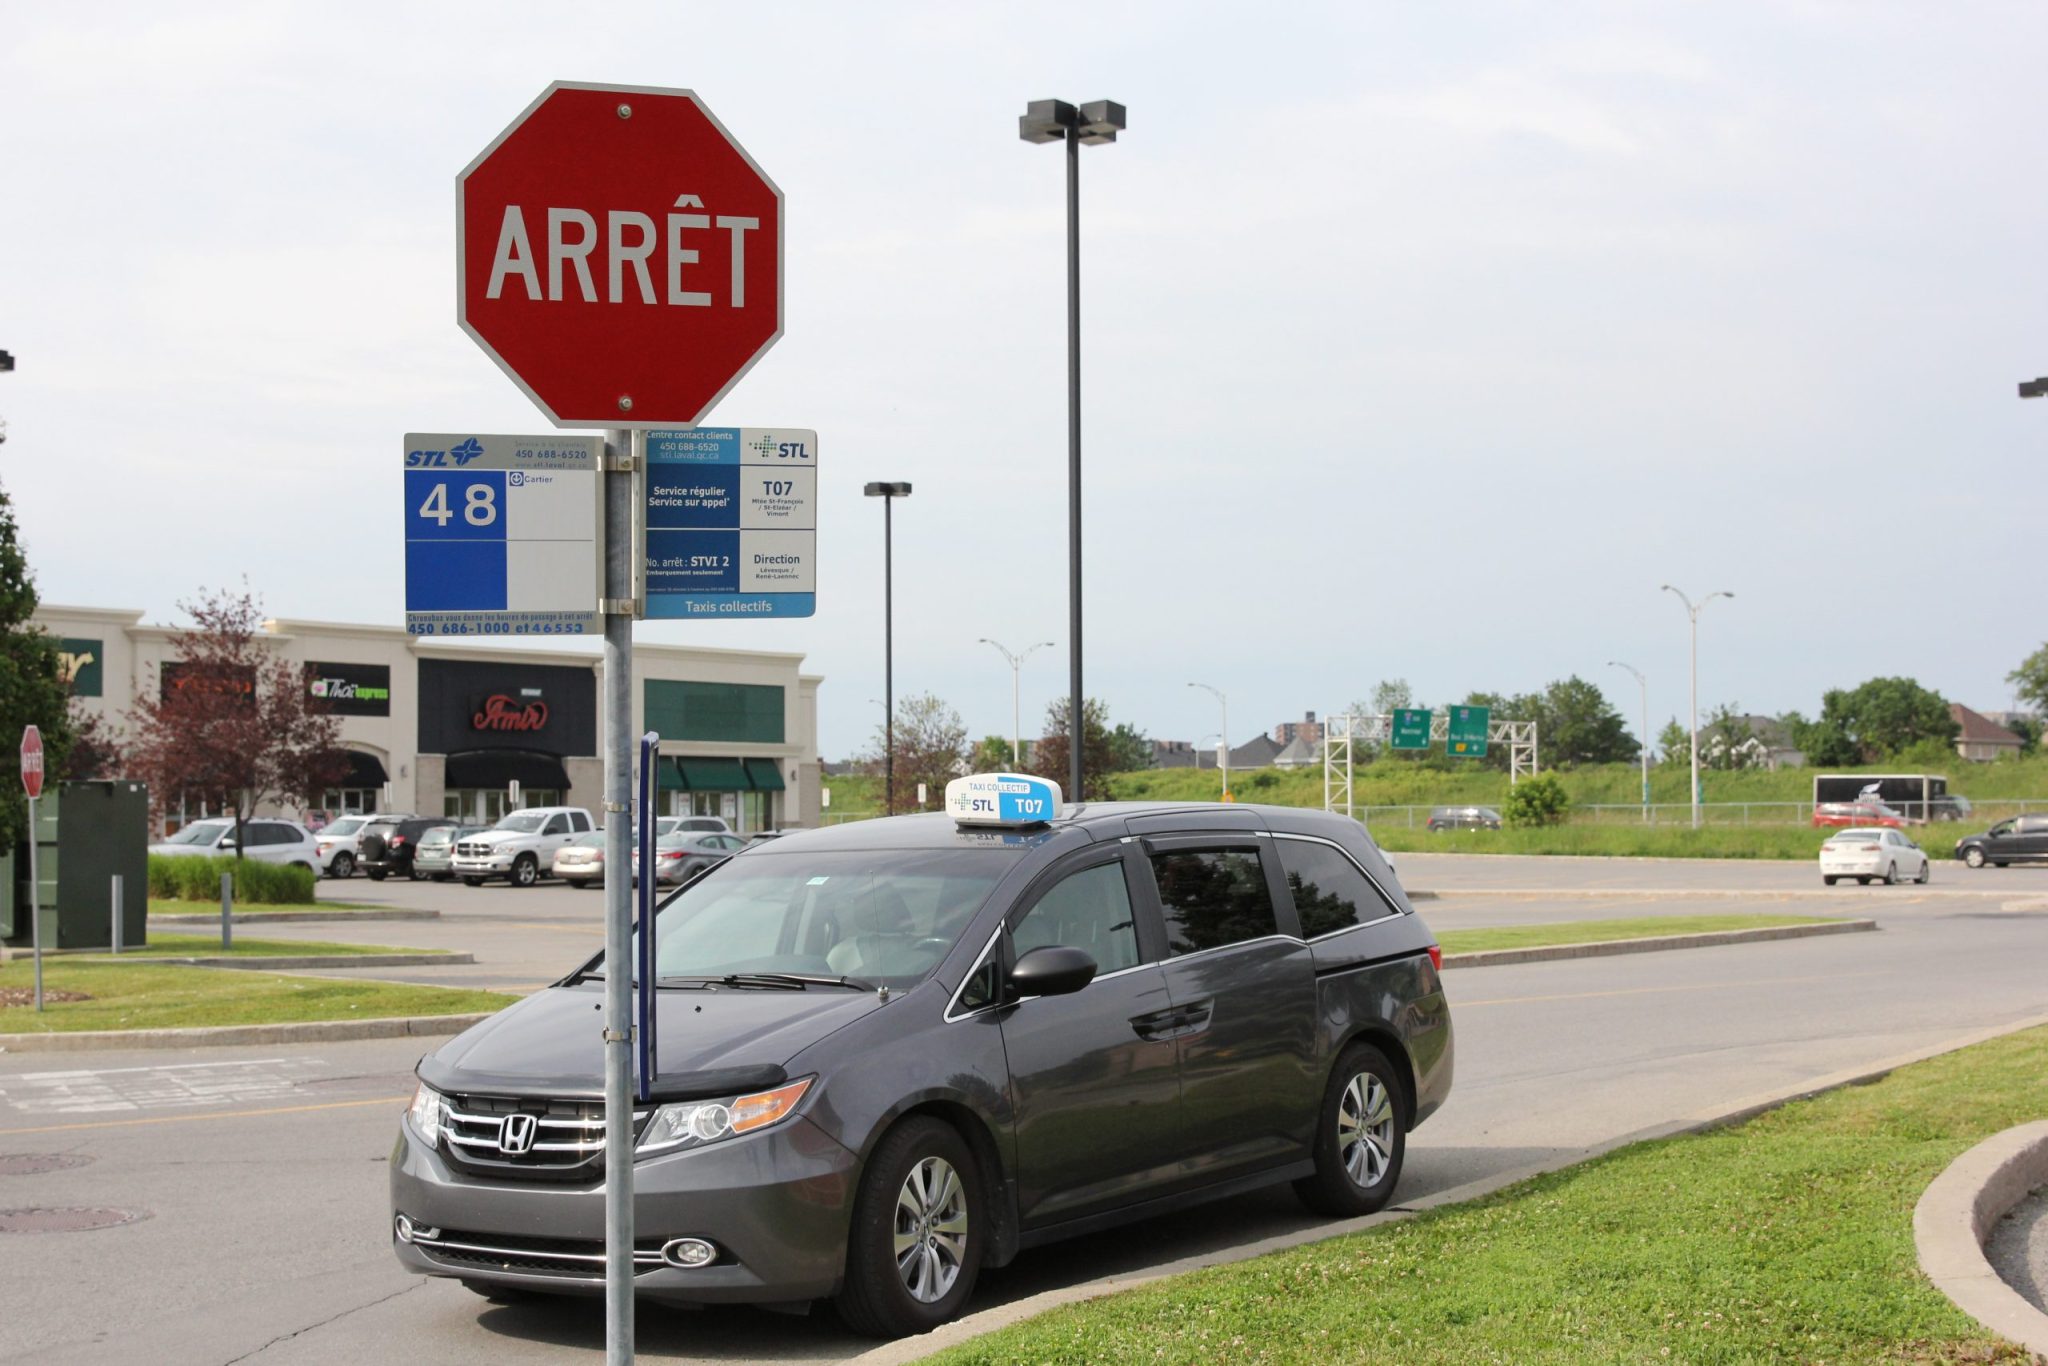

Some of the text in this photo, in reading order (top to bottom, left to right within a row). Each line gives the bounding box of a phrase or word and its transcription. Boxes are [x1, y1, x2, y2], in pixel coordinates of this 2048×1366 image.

[486, 194, 759, 308] ARRÊT
[646, 430, 733, 440] Centre contact clients
[660, 442, 719, 451] 450 688-6520
[778, 443, 809, 458] STL
[405, 450, 448, 467] STL
[515, 450, 587, 459] 450 688-6520
[524, 475, 553, 483] Cartier
[653, 485, 726, 498] Service régulier
[763, 481, 793, 496] T07
[419, 483, 497, 526] 48
[648, 497, 683, 506] Service
[684, 498, 700, 507] sur
[690, 556, 718, 567] STVI
[722, 556, 730, 567] 2
[754, 554, 800, 564] Direction
[760, 567, 789, 575] Lévesque
[685, 599, 773, 613] Taxis collectifs
[446, 613, 462, 621] vous
[463, 613, 483, 621] donne
[485, 612, 495, 621] les
[497, 612, 519, 621] heures
[521, 612, 529, 621] de
[530, 612, 557, 623] passage
[565, 612, 575, 621] cet
[577, 611, 593, 621] arrêt
[408, 623, 434, 634] 450
[441, 623, 510, 634] 686-1000
[515, 623, 530, 633] et
[473, 694, 549, 731] Amir
[969, 783, 1028, 793] TAXI COLLECTIF
[972, 798, 1043, 814] STL T07
